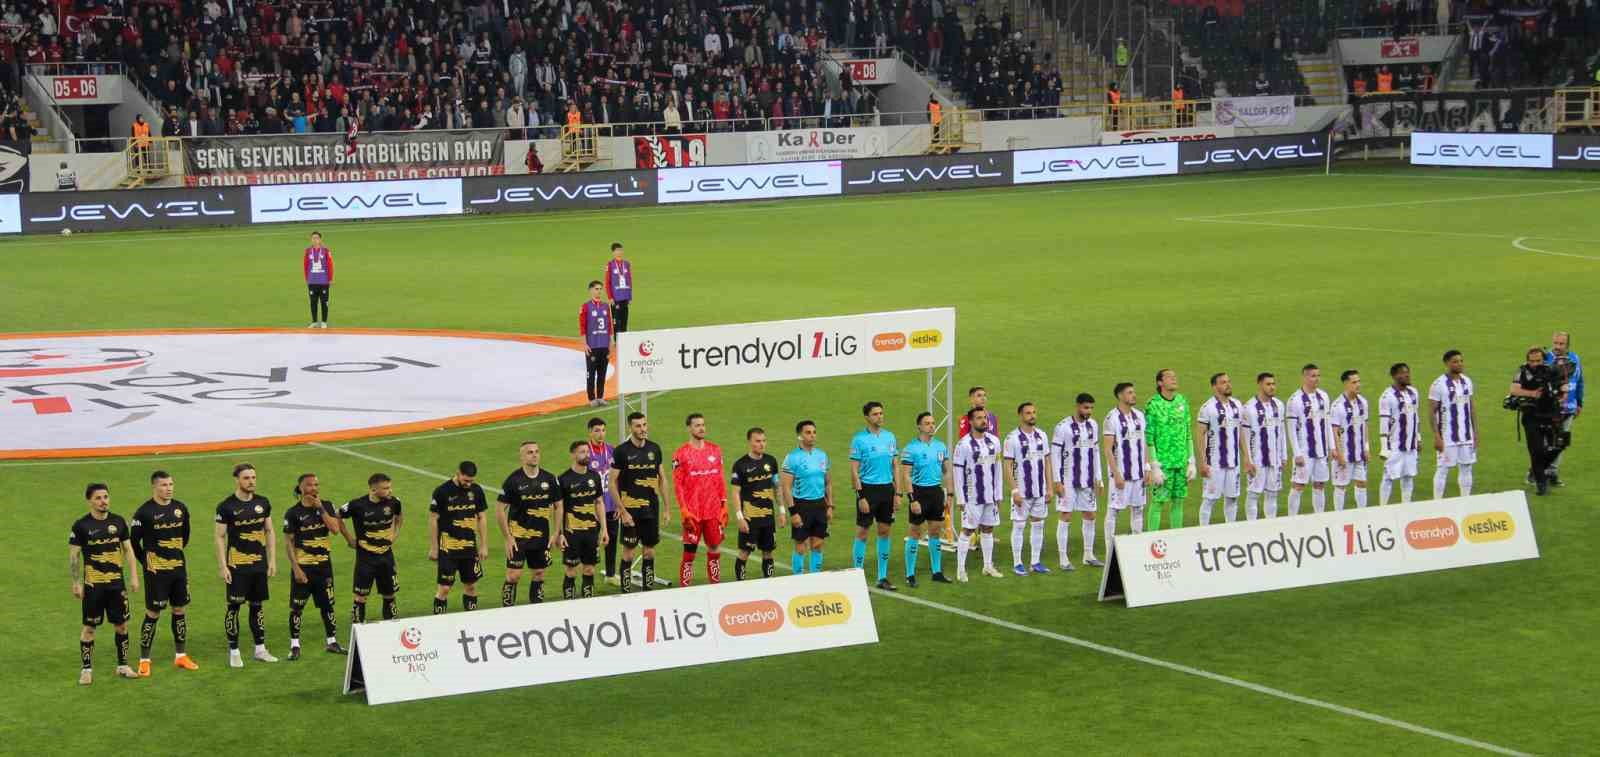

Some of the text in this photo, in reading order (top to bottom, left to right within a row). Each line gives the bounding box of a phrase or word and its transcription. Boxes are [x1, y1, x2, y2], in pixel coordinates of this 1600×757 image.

[863, 63, 876, 79] D8
[55, 80, 70, 97] D5
[80, 79, 96, 97] D6
[777, 131, 856, 147] Ka Der
[454, 140, 492, 161] AMA
[1184, 143, 1324, 165] JEWEL
[1417, 145, 1541, 159] JEWEL
[1021, 154, 1166, 174] JEWEL
[665, 174, 828, 193] JEWEL
[849, 165, 1001, 185] JEWEL
[261, 192, 447, 213] JEWEL
[470, 183, 645, 204] JEWEL
[597, 318, 605, 329] 3
[678, 334, 802, 368] trendyol
[1409, 527, 1456, 542] trendyol
[1195, 527, 1334, 573] trendyol
[724, 607, 779, 627] trendyol
[795, 600, 845, 619] NESİNE
[457, 611, 632, 664] trendyol
[391, 649, 438, 665] trendyol
